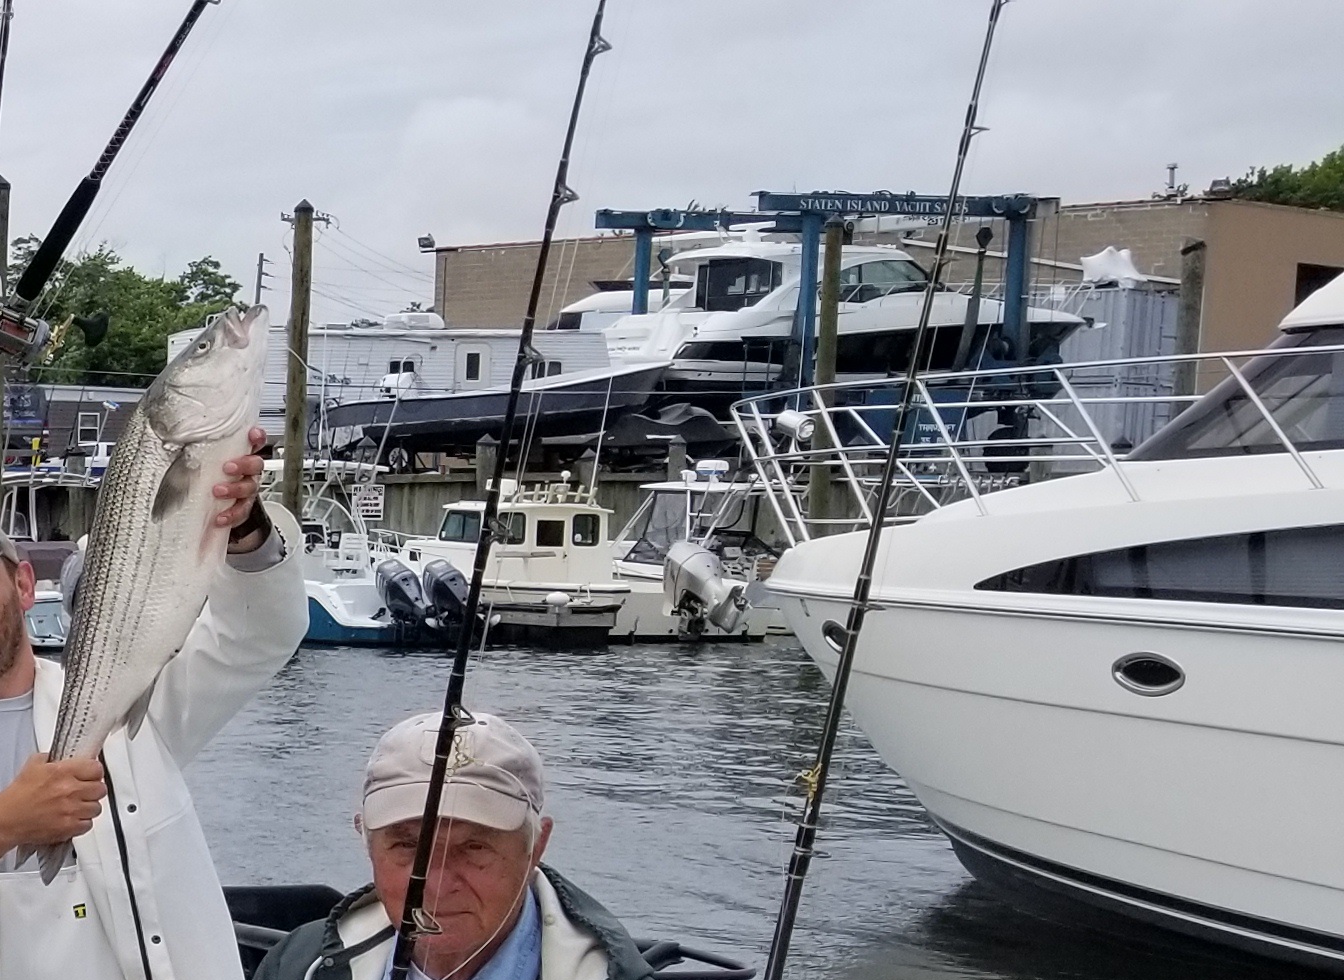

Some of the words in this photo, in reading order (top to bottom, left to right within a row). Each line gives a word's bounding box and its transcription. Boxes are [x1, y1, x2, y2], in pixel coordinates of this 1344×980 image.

[799, 198, 844, 211] STATEN
[847, 199, 890, 212] ISLAND
[895, 200, 932, 213] YACHT
[933, 201, 970, 214] SAES
